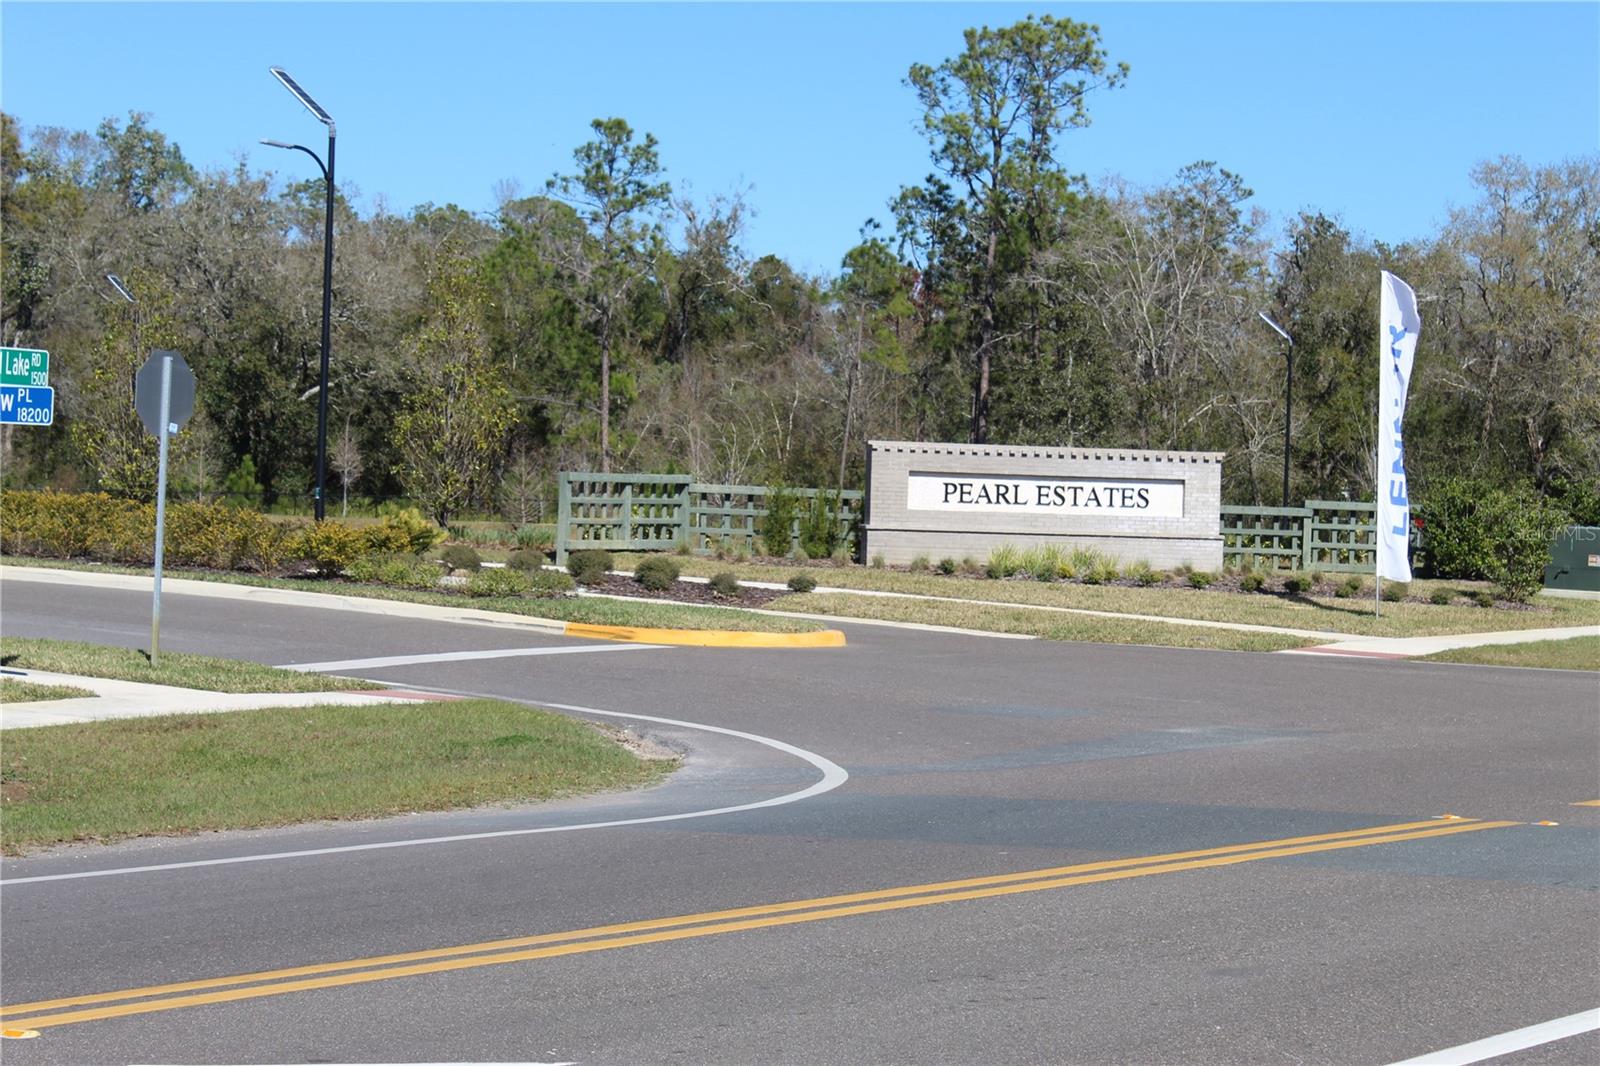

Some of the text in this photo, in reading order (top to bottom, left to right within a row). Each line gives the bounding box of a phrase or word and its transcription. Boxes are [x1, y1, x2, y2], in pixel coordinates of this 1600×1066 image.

[6, 352, 30, 376] Lake
[31, 353, 41, 367] RD
[31, 371, 47, 386] 1500
[17, 388, 32, 403] PL
[17, 407, 49, 422] 18200
[942, 482, 1150, 509] PEARL ESTATES
